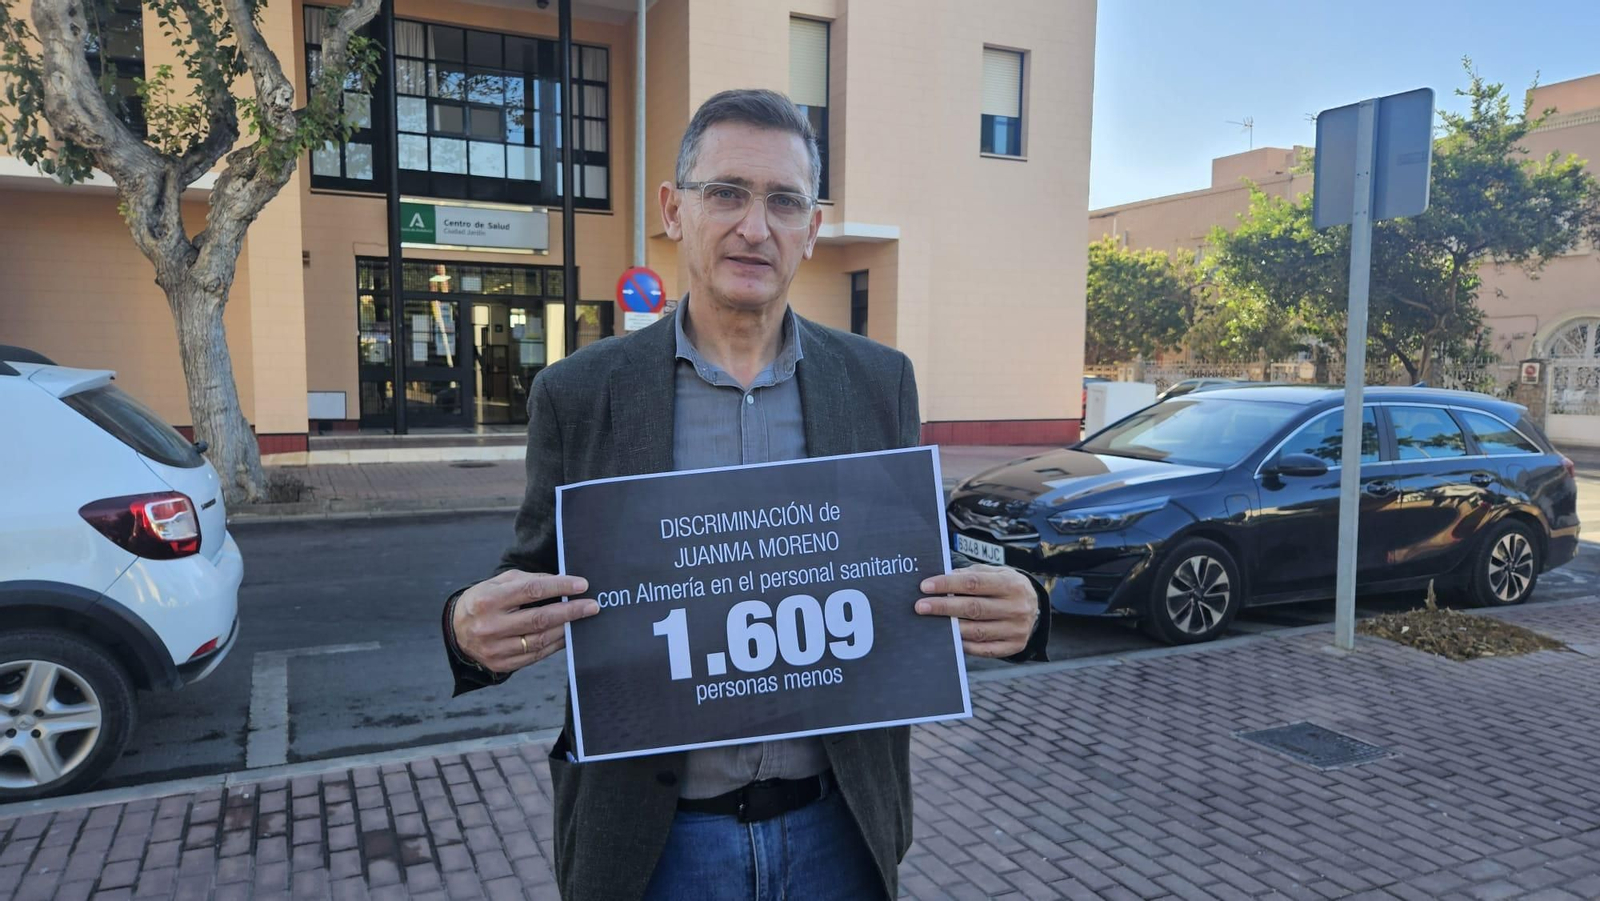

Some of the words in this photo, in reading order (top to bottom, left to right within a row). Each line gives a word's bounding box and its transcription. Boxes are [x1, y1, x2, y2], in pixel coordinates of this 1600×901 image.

[443, 219, 472, 229] Centro
[474, 220, 485, 229] de
[487, 222, 511, 231] Salud
[660, 501, 814, 539] DISCRIMINACIÓN
[819, 502, 841, 522] de
[674, 540, 754, 569] JUANMA
[758, 531, 840, 559] MORENO
[597, 588, 631, 609] con
[636, 576, 705, 604] Almería
[710, 576, 732, 595] en
[738, 570, 754, 592] el
[760, 561, 835, 594] personal
[840, 554, 919, 580] sanitario:
[652, 588, 875, 681] 1.609
[696, 675, 779, 705] personas
[784, 667, 843, 690] menos
